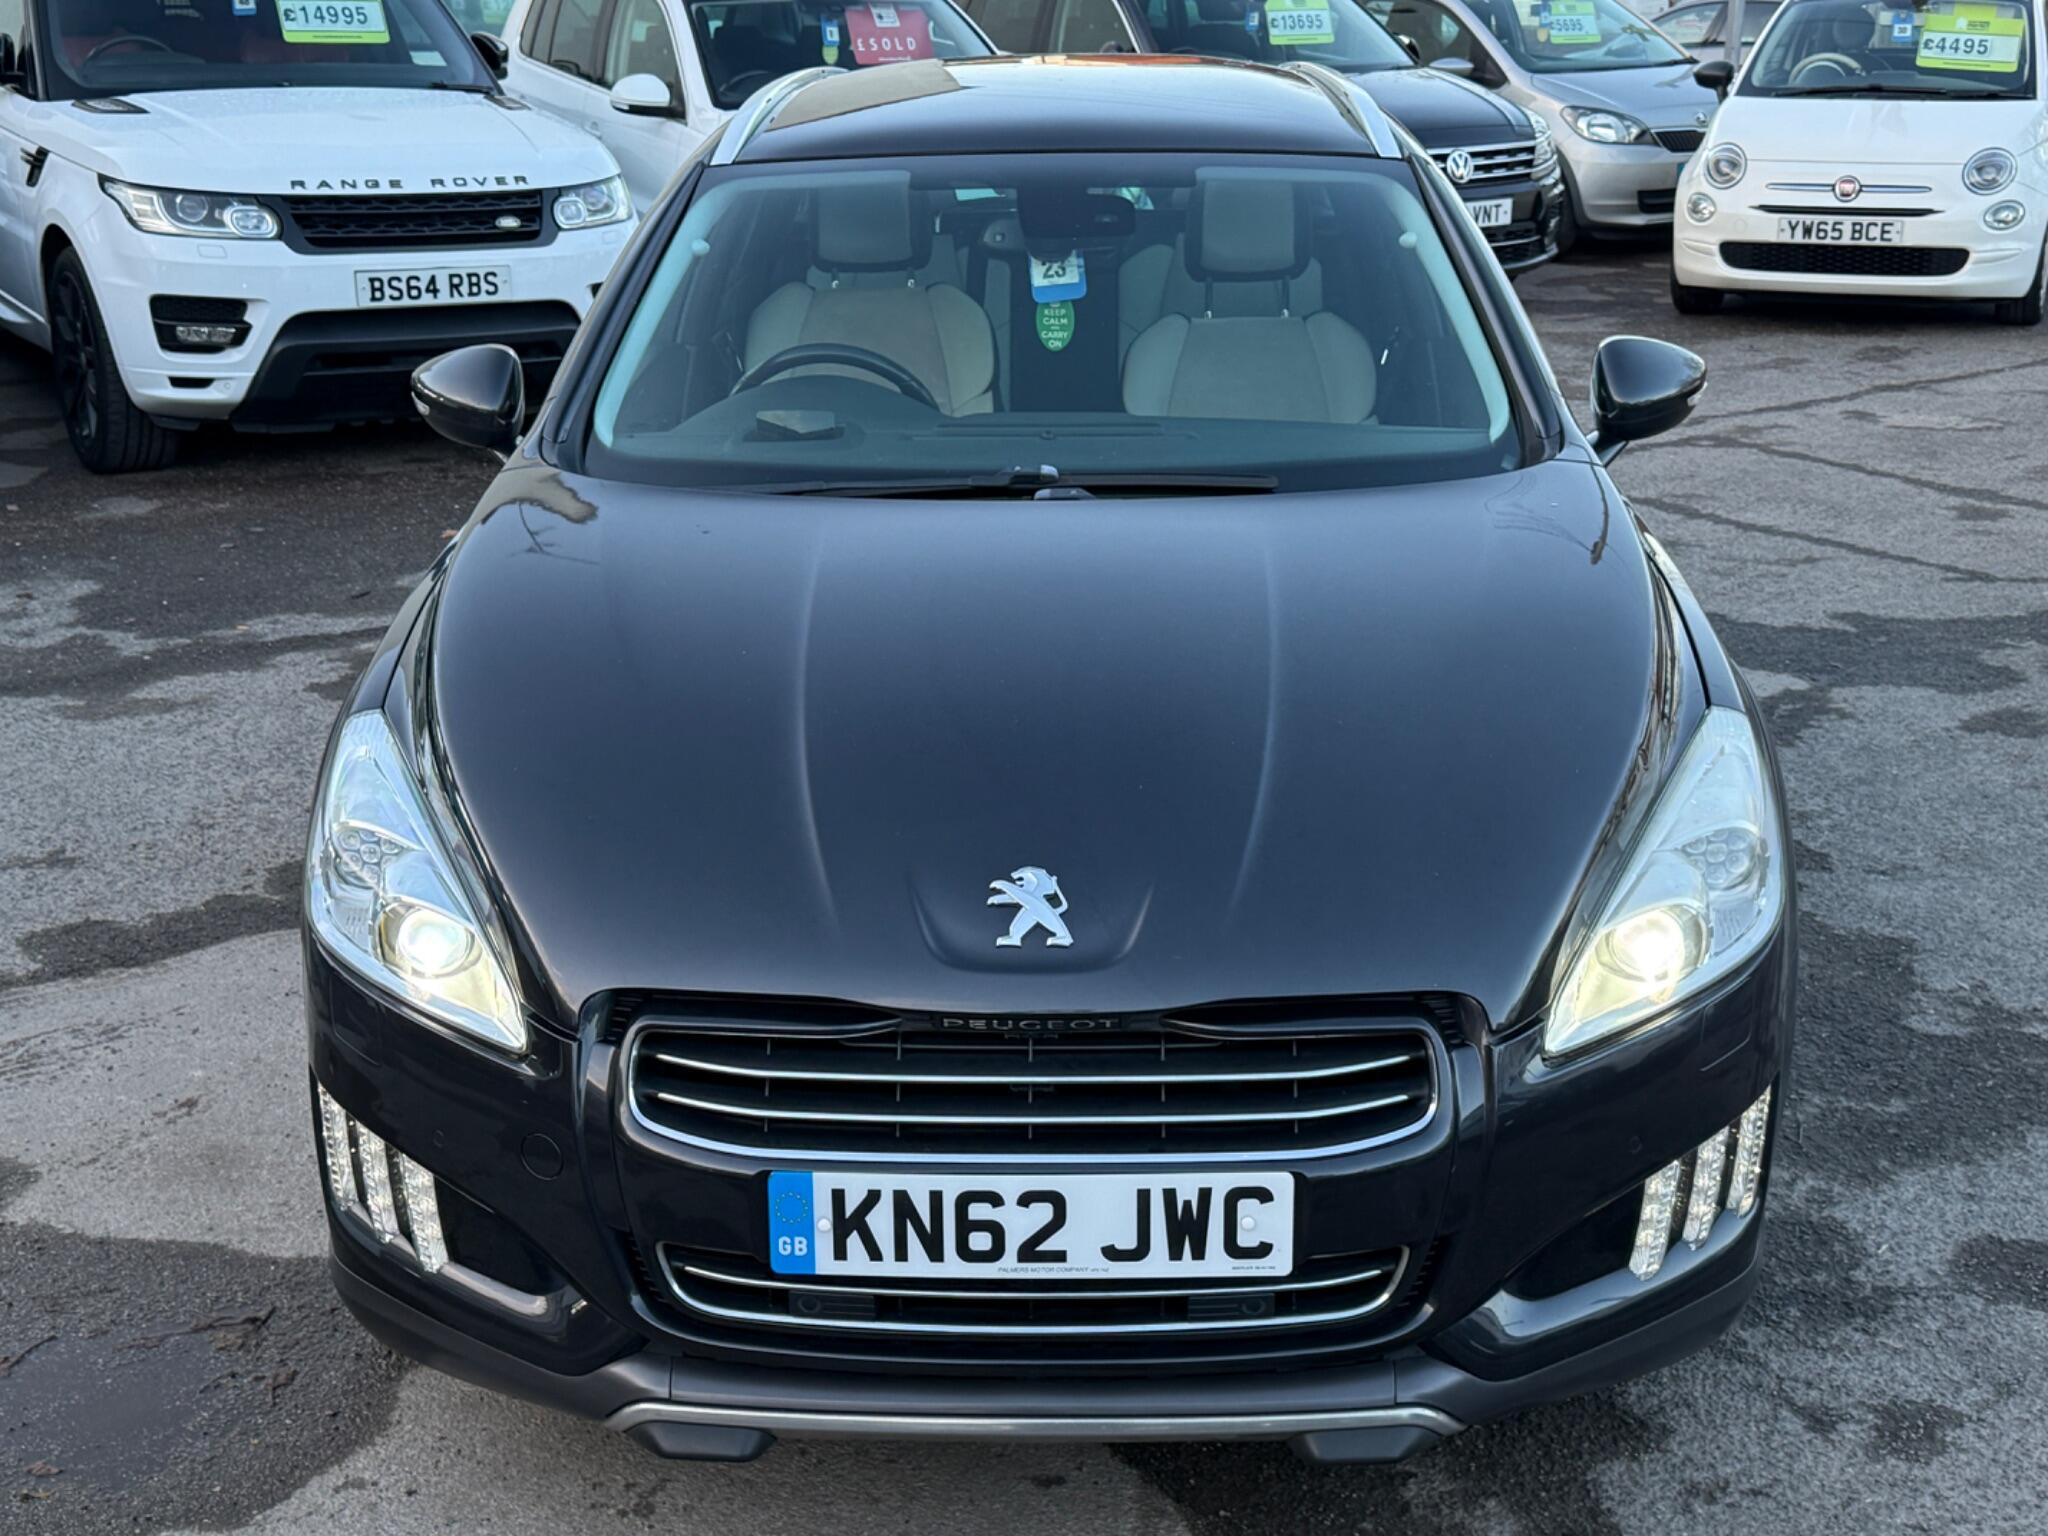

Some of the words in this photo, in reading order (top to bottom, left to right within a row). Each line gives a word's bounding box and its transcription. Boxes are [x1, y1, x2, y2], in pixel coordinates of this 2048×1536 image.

[284, 6, 369, 25] £14995
[1271, 13, 1324, 30] £13695
[1923, 37, 1990, 55] £4495
[290, 178, 404, 190] RANGE
[430, 175, 529, 188] ROVER
[1787, 219, 1844, 241] YW65
[1850, 221, 1895, 242] BCE
[368, 273, 441, 302] BS64
[449, 271, 500, 298] RBS
[1043, 308, 1067, 317] KEEP
[1042, 317, 1068, 326] CALM
[1041, 330, 1068, 339] CARRY
[1047, 340, 1063, 348] ON
[943, 1018, 1120, 1030] PEUGEOT
[831, 1188, 1068, 1264] KN62
[1100, 1186, 1275, 1263] JWC
[777, 1236, 808, 1257] GB
[1030, 1266, 1056, 1274] MOTOR
[1056, 1266, 1088, 1274] COMPANY
